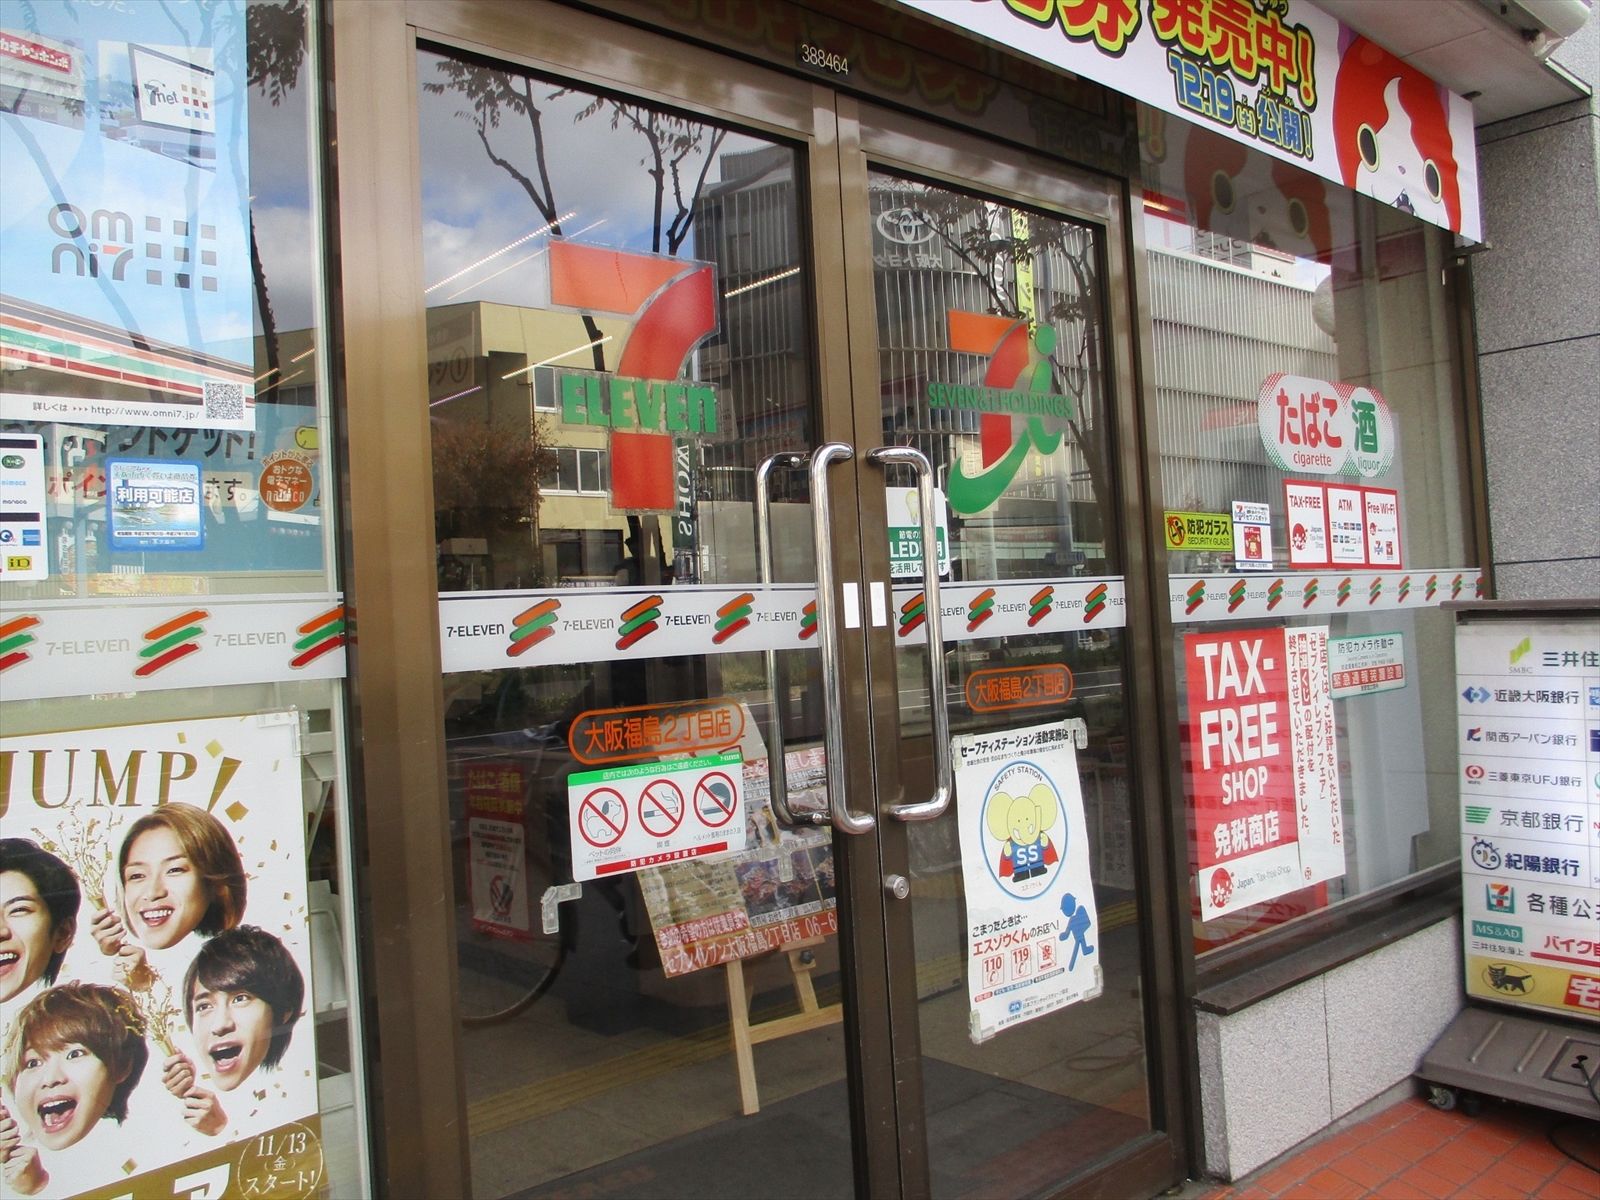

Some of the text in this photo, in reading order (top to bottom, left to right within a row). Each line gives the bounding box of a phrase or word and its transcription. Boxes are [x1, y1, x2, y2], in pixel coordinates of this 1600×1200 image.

[801, 43, 849, 76] 388464
[1256, 96, 1313, 158] 公開!
[33, 401, 200, 421] 詳しくは http://www.omni7.jp/
[1276, 386, 1343, 449] たばこ
[1351, 398, 1379, 454] 酒
[272, 465, 304, 475] おトクな
[1292, 450, 1333, 468] cigarette
[1357, 456, 1381, 472] liquor
[266, 475, 308, 486] 電子マネー
[117, 487, 194, 504] 利用可能店
[1337, 498, 1354, 512] ATM
[1367, 501, 1380, 515] Free
[1186, 518, 1230, 537] 防犯ガラス
[1187, 536, 1231, 547] SECURITY GLASS
[1337, 638, 1395, 655] 防犯カメラ作動中
[1508, 666, 1534, 675] SMBC
[975, 673, 1067, 704] 大阪福島2丁目店
[1493, 688, 1580, 705] 近畿大阪銀行
[584, 707, 734, 754] 大阪福島2丁目店
[1199, 701, 1280, 771] FREE
[1288, 635, 1311, 835] 終了させていただきました。
[1485, 730, 1578, 747] 関西アーバン銀行
[960, 728, 1069, 759] セーフティステーション活動実施店
[993, 765, 1043, 792] SAFETY STATION
[1221, 765, 1268, 806] SHOP
[1487, 770, 1583, 788] 三菱東京UFJ銀行
[1499, 809, 1585, 833] 京都銀行
[1213, 810, 1280, 859] 免税商店
[1016, 844, 1039, 866] SS
[1504, 852, 1580, 878] 紀陽銀行
[972, 919, 1061, 957] エスゾウくんのお店へ!
[1474, 923, 1520, 939] MS&AD
[984, 947, 1030, 973] 110 119
[256, 1131, 307, 1157] 11/13
[264, 1155, 296, 1172] (金)
[246, 1169, 316, 1195] スタート!
